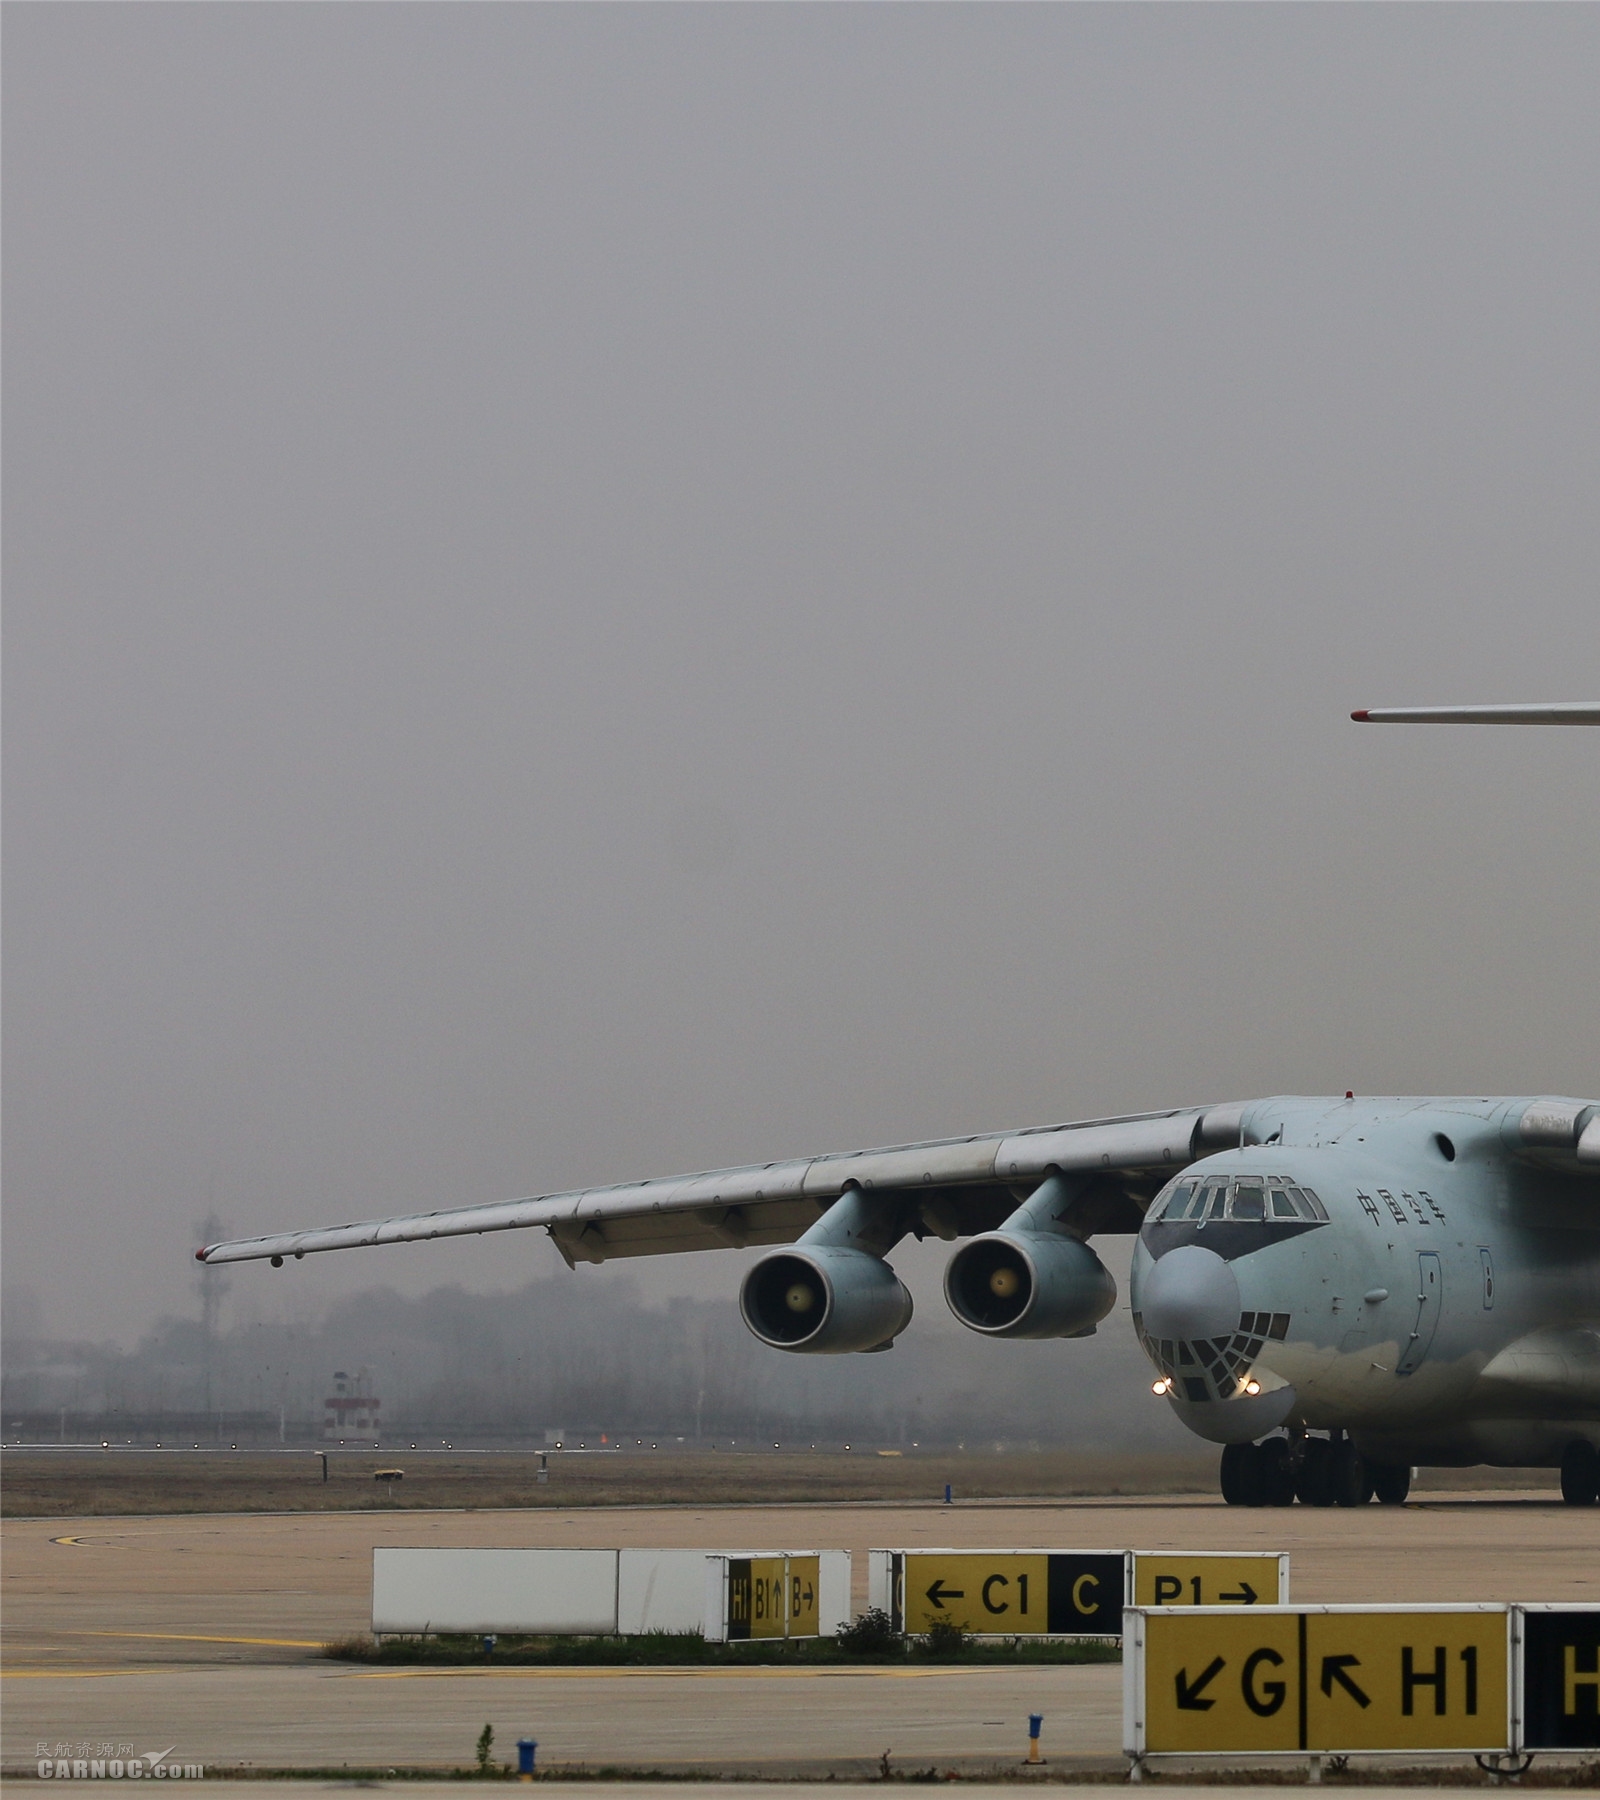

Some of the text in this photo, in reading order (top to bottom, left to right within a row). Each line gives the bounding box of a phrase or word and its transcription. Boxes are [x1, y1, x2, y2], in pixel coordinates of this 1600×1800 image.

[1356, 1187, 1446, 1227] 中国空军
[756, 1577, 769, 1620] B1
[792, 1576, 801, 1618] B
[981, 1573, 1201, 1615] C1 C P1
[1241, 1647, 1286, 1718] G
[1401, 1645, 1477, 1716] H1
